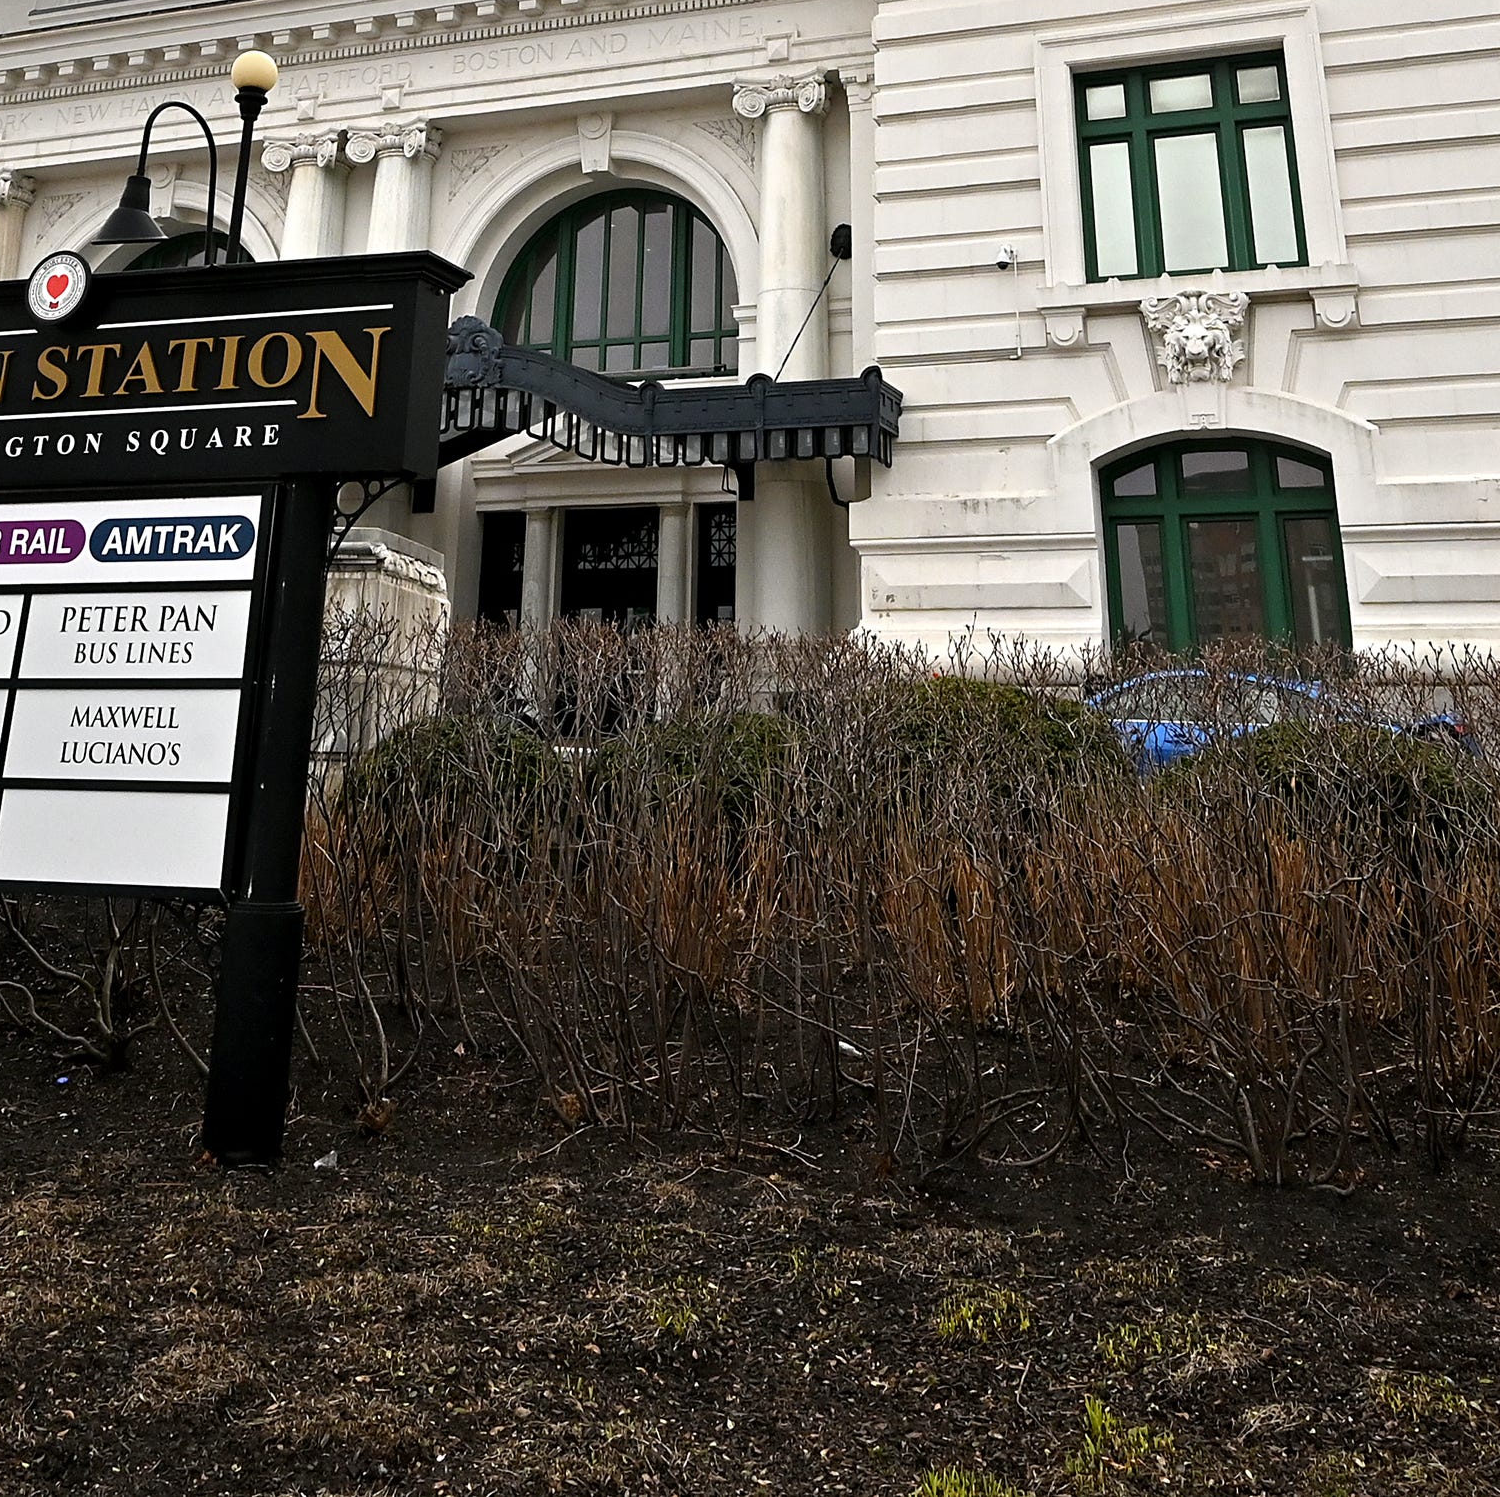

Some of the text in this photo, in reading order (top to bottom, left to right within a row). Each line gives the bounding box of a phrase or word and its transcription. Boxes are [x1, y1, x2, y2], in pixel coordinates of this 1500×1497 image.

[30, 326, 392, 420] STATION
[126, 424, 280, 456] SQUARE
[9, 527, 71, 556] RAIL
[101, 523, 242, 556] AMTRAK
[59, 604, 218, 633] PETER PAN
[74, 641, 194, 665] BUS LINES
[70, 705, 179, 729] MAXWELL
[59, 741, 181, 766] LUCIANO'S
